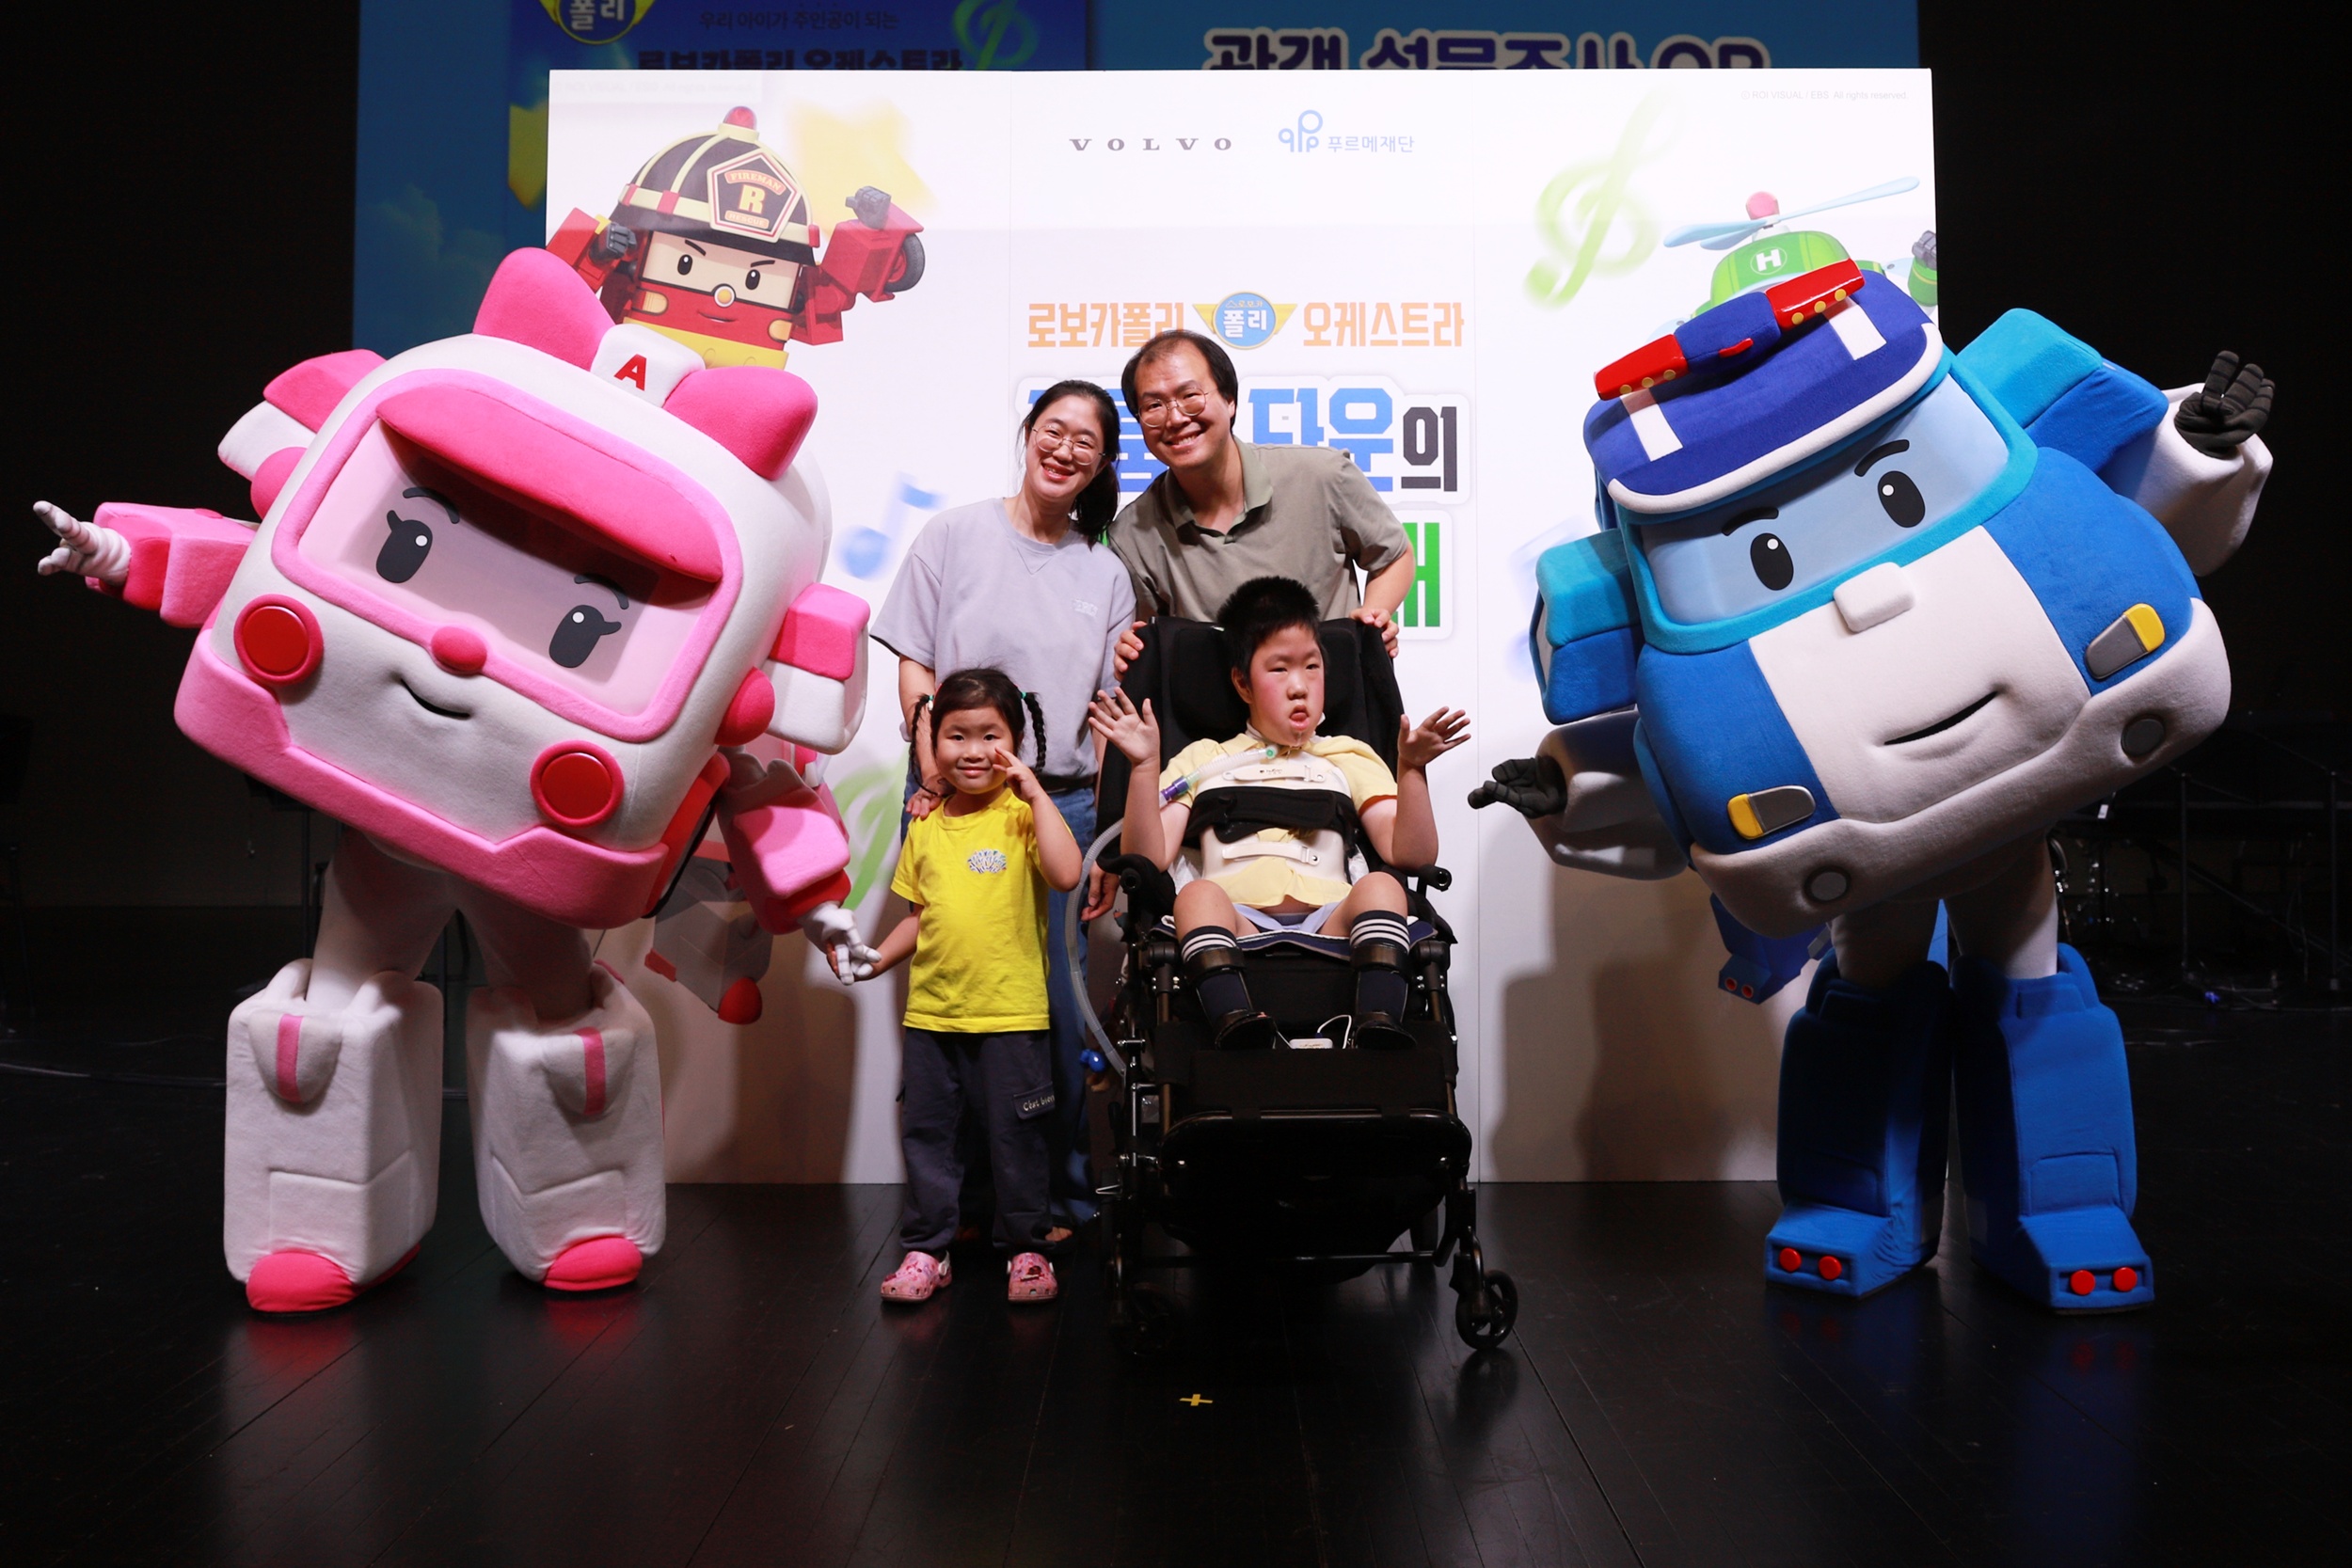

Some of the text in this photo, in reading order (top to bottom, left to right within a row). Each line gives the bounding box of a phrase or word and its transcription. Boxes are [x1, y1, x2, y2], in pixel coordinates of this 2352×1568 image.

[700, 11, 900, 29] 우리 아이가 주인공이 되는
[1752, 90, 1769, 100] ROI
[1771, 90, 1804, 100] VISUAL
[1811, 90, 1829, 100] EBS
[1834, 90, 1845, 100] All
[1846, 90, 1868, 102] rights
[1069, 137, 1232, 151] VOLVO
[1327, 135, 1416, 152] 푸르메재단
[730, 171, 782, 191] FIREMAN
[739, 184, 766, 214] R
[729, 213, 765, 226] RESCUE
[1756, 248, 1782, 272] H
[1027, 302, 1184, 348] 로보카폴리
[1223, 309, 1267, 338] 폴리
[1303, 302, 1465, 347] 오케스트라
[613, 354, 647, 391] A
